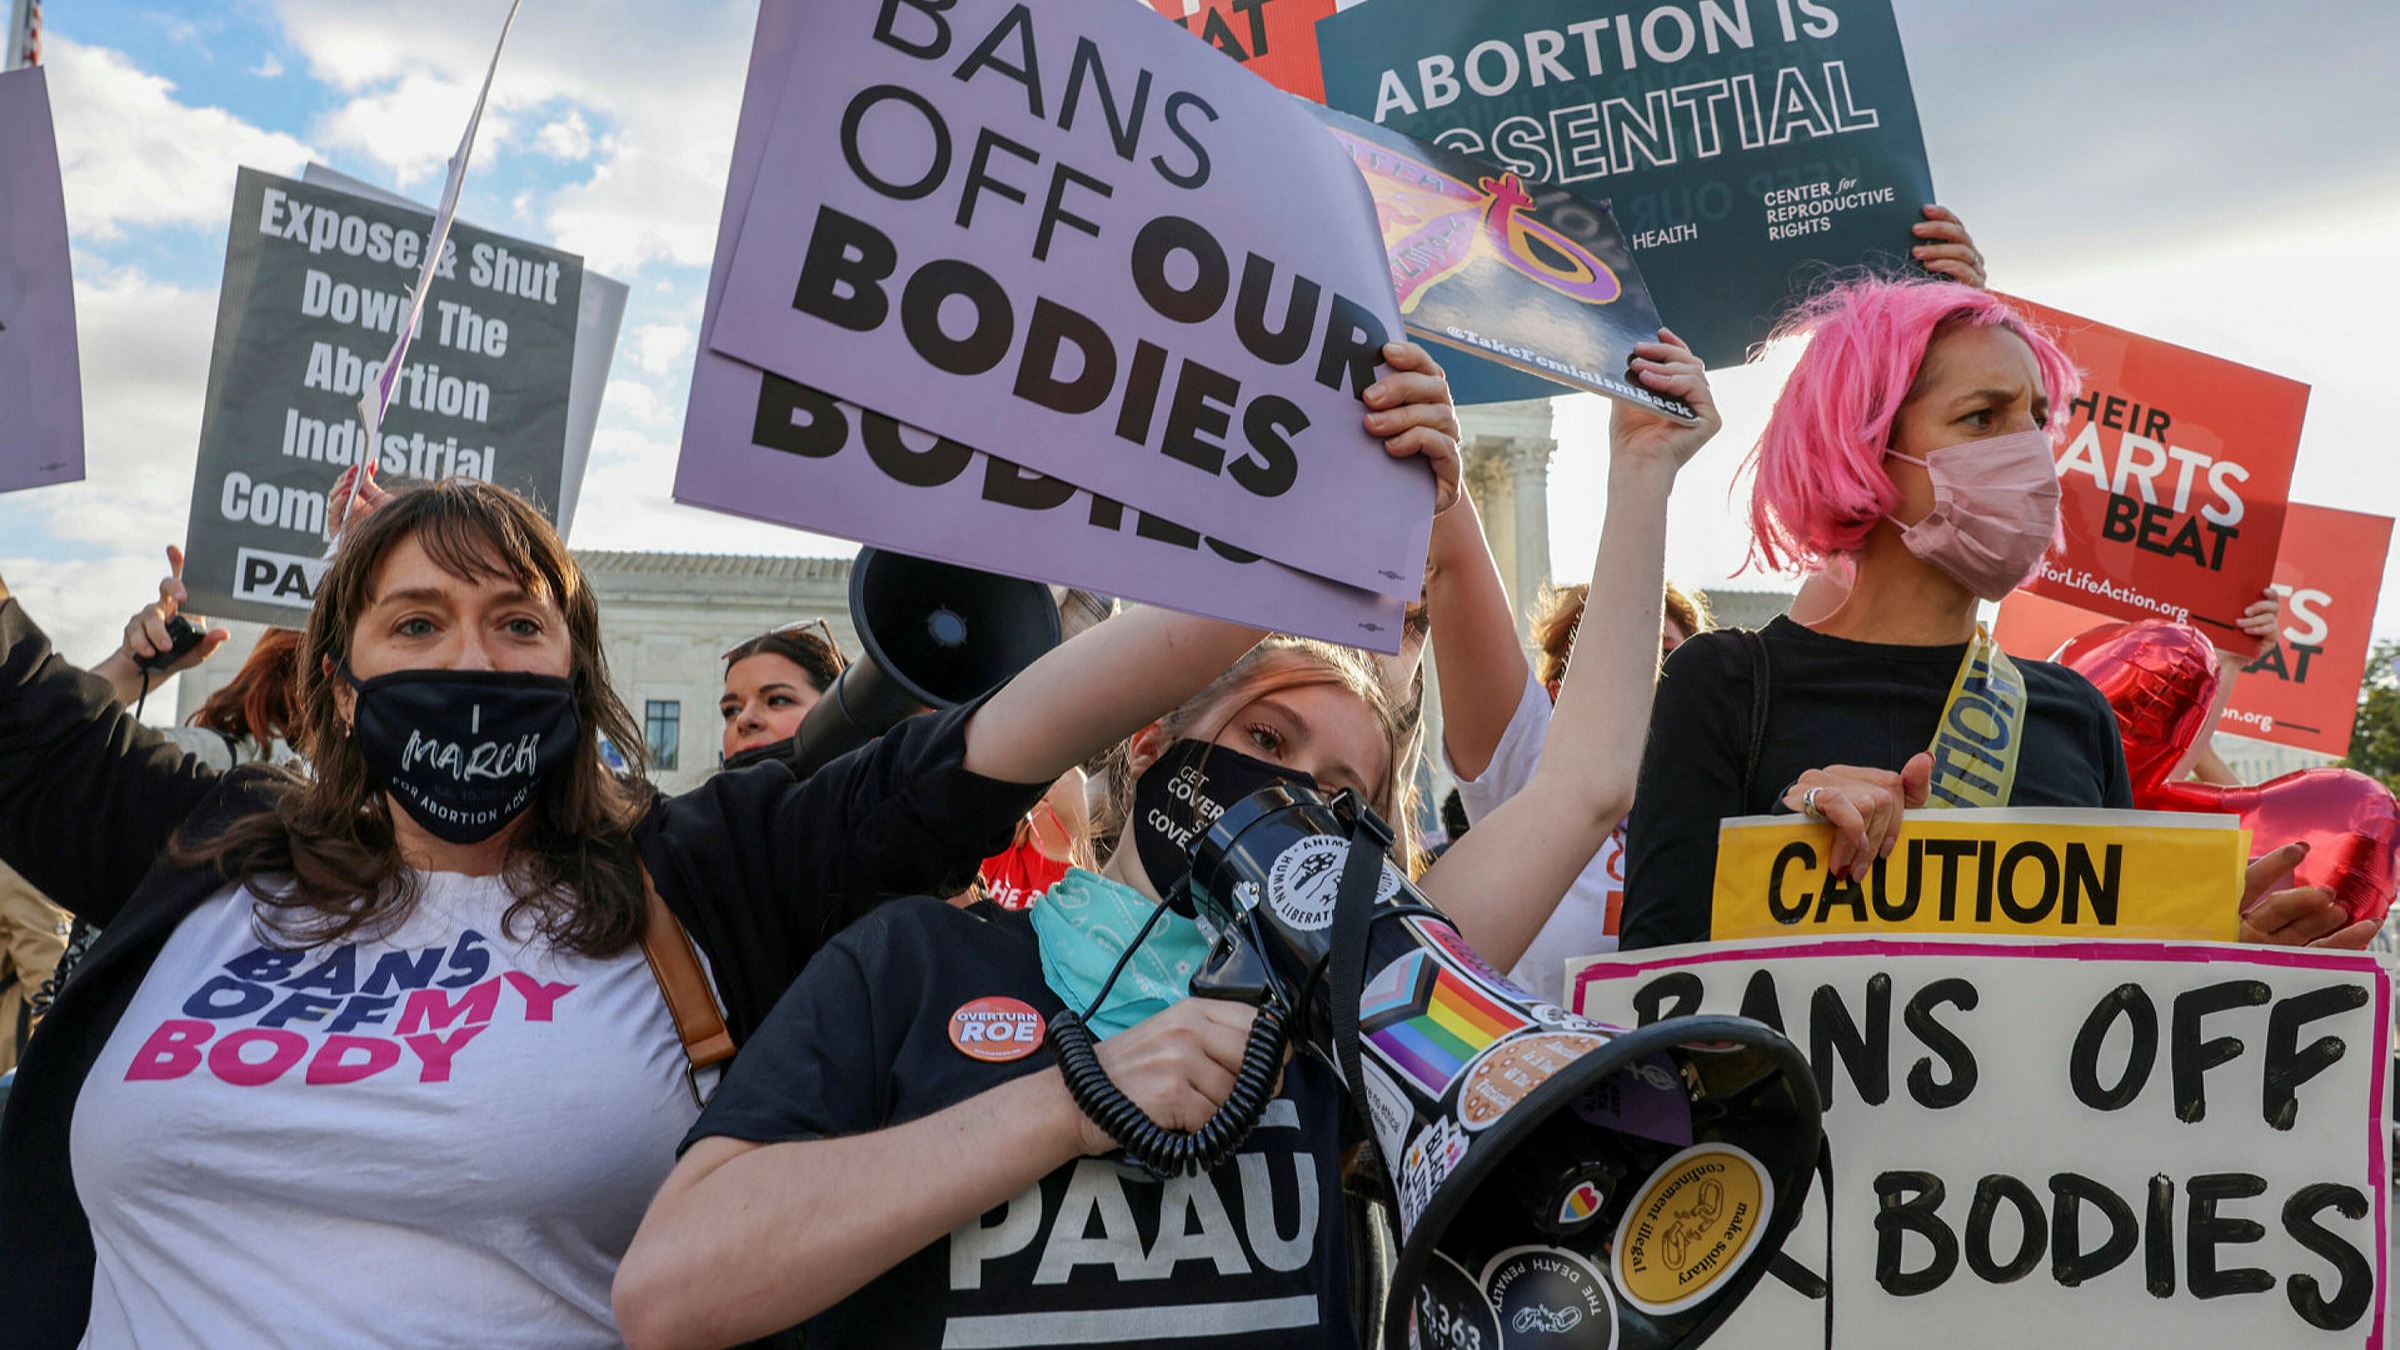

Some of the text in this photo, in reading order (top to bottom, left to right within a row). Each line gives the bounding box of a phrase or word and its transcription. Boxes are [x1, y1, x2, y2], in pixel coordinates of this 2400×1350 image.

[1174, 0, 1274, 63] AT
[1374, 0, 1840, 122] ABORTION IS
[1763, 177, 1858, 206] CENTER for
[1766, 187, 1895, 224] REPRODUCTIVE
[259, 188, 419, 269] Expose
[470, 242, 560, 305] Shut
[841, 84, 1113, 262] OFF
[1131, 215, 1388, 401] OUR
[1632, 222, 1698, 250] HEALTH
[1769, 216, 1831, 241] RIGHTS
[438, 301, 509, 358] The
[792, 204, 1312, 498] BODIES
[2102, 492, 2240, 572] BEAT
[243, 556, 316, 601] PA
[2032, 561, 2190, 624] forLifeAction.org
[471, 703, 481, 734] I
[1930, 659, 2019, 809] TION
[401, 728, 541, 783] MARCH
[392, 775, 419, 798] FOR
[420, 795, 498, 826] ABORTION
[1147, 808, 1193, 853] COVE
[1273, 855, 1334, 925] HUMAN LIBERAT
[1768, 838, 2124, 926] CAUTION
[222, 929, 491, 996] BANS
[181, 970, 580, 1036] OFF MY
[956, 1011, 1038, 1023] OVERTURN
[959, 1021, 1038, 1044] ROE
[123, 1019, 490, 1087] BODY
[2069, 980, 2370, 1131] OFF
[949, 1150, 1321, 1291] PAAU
[1631, 1163, 1727, 1274] confinement illegal
[1677, 1201, 1748, 1287] make solitary
[1874, 1170, 2374, 1330] BODIES
[1493, 1258, 1602, 1317] THE DEATH PENALTY
